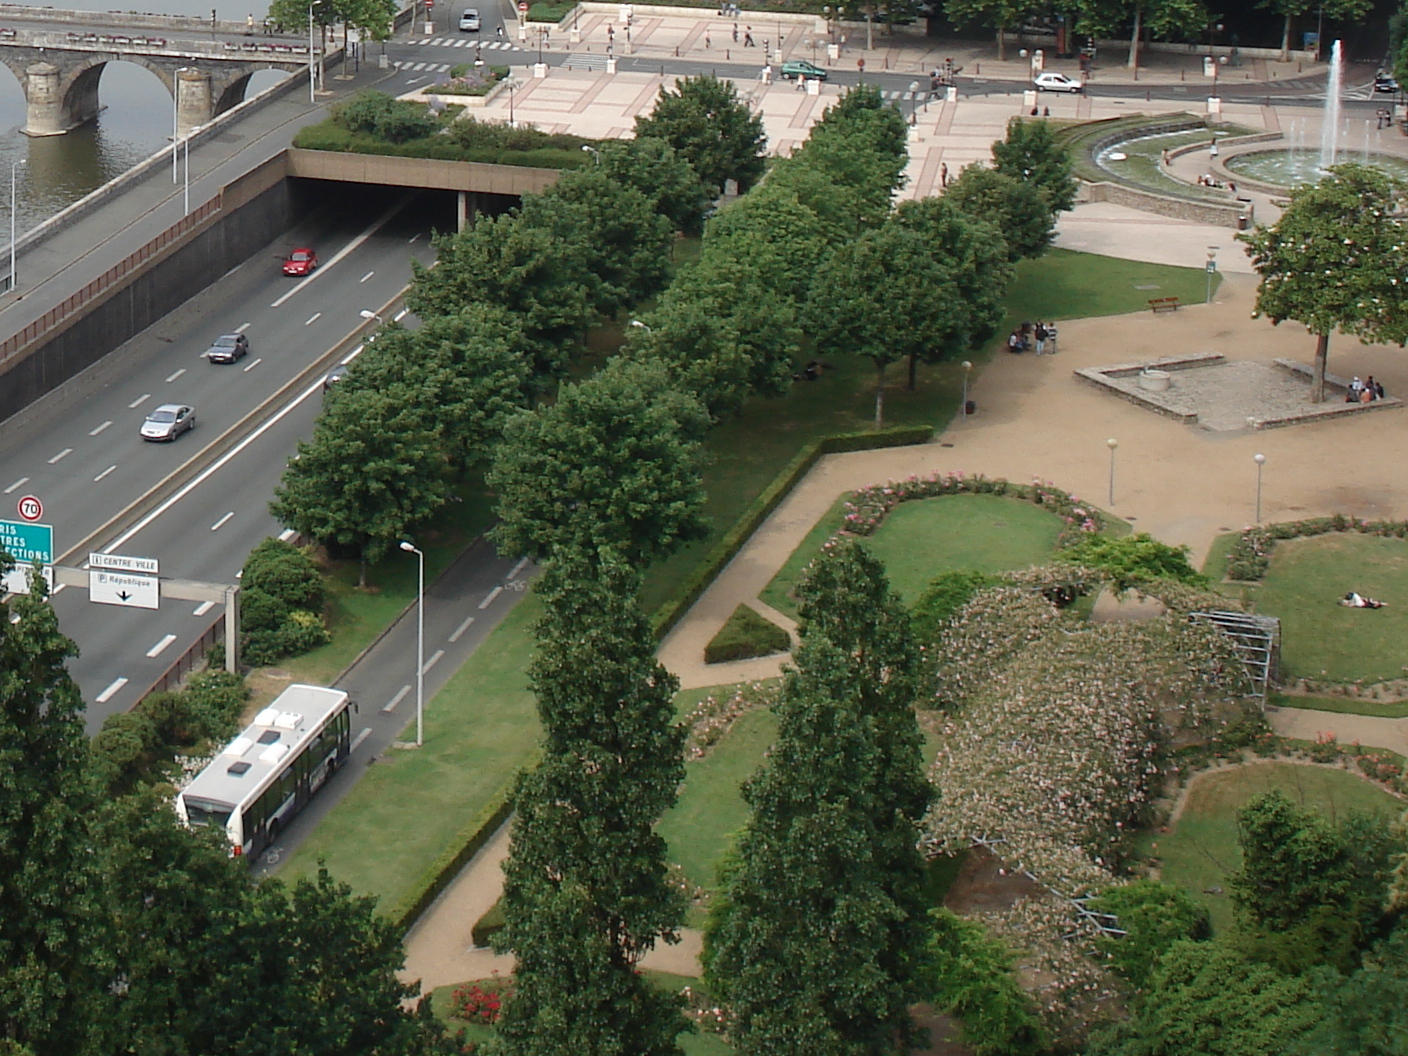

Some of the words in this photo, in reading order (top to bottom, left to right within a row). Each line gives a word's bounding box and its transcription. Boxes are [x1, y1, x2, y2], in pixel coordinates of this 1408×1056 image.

[24, 503, 38, 514] 70
[103, 557, 132, 567] CENTRE
[136, 561, 155, 570] VILLE
[109, 575, 151, 587] République
